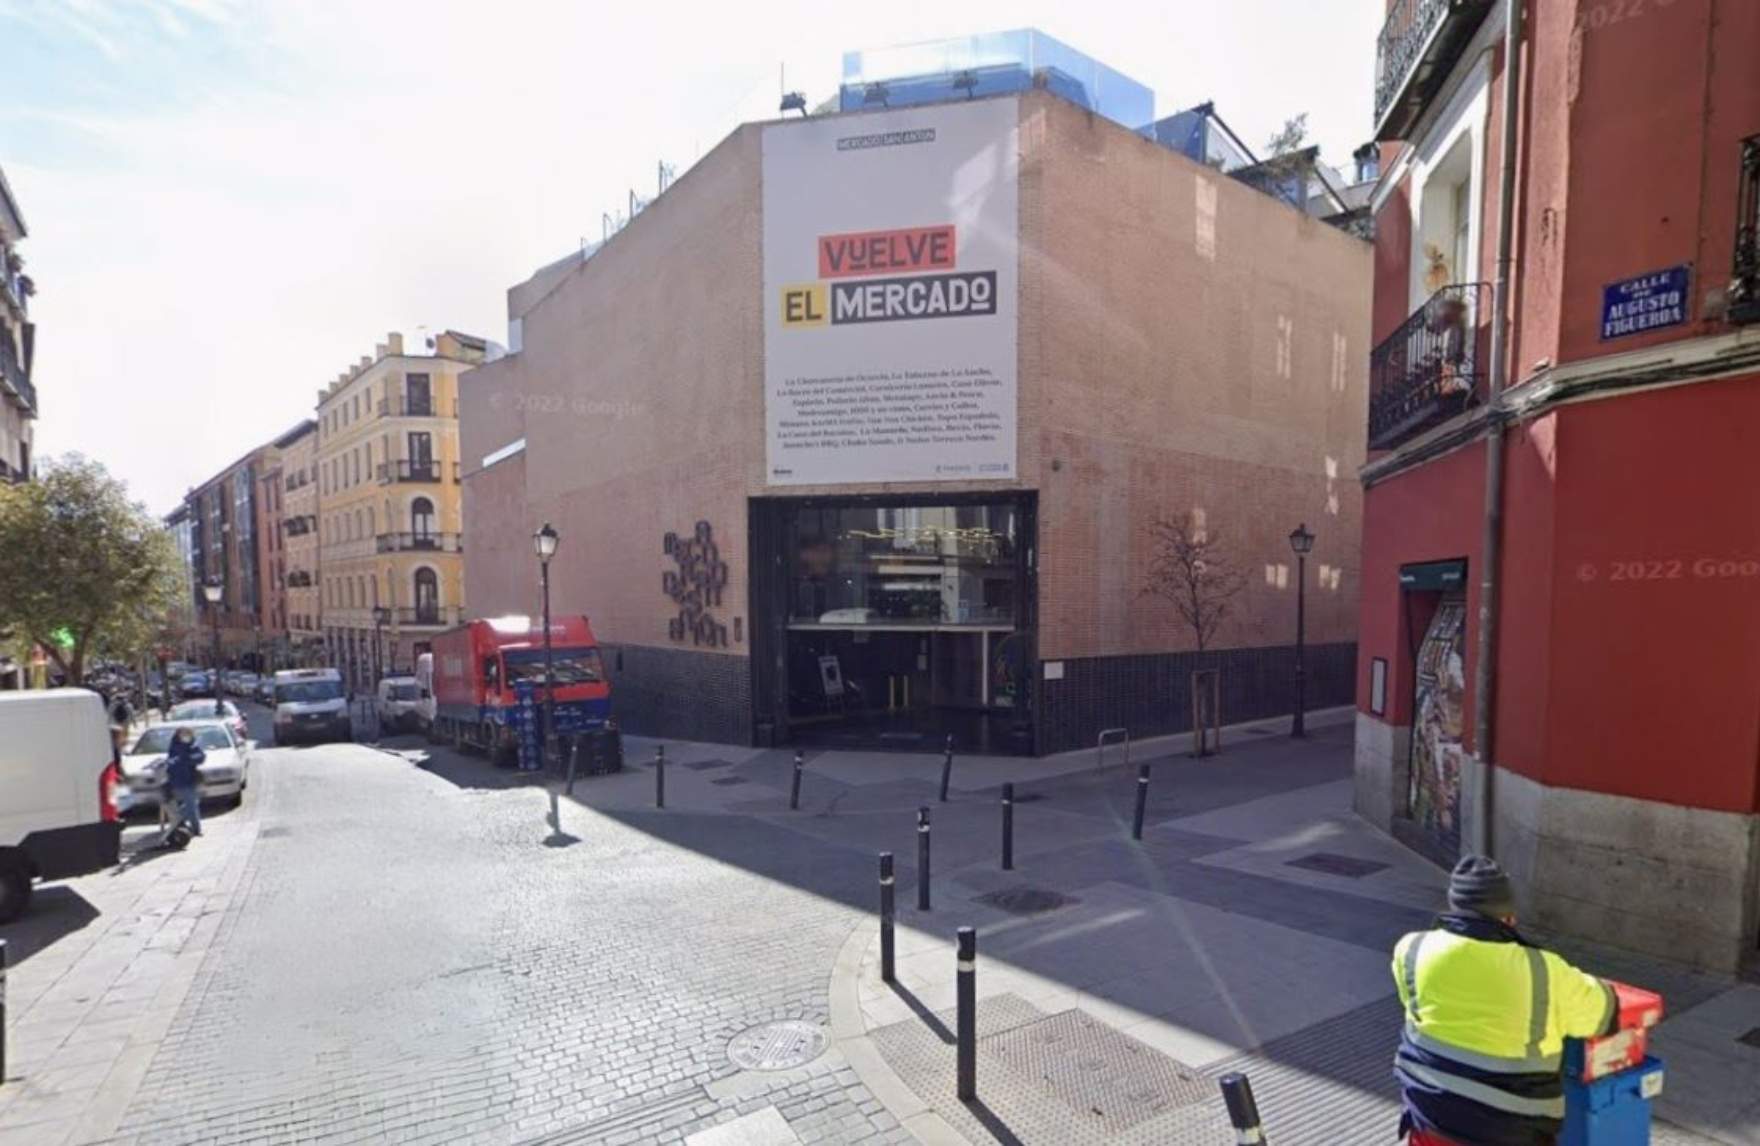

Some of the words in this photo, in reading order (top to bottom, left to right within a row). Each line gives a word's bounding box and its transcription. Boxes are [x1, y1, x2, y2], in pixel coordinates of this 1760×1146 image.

[824, 231, 950, 272] VUELVE
[1620, 273, 1671, 293] CALLE
[785, 290, 822, 322] EL
[836, 276, 991, 321] MERCADO
[1608, 291, 1680, 320] AUGUSTO
[1604, 306, 1682, 337] FIGUEROA
